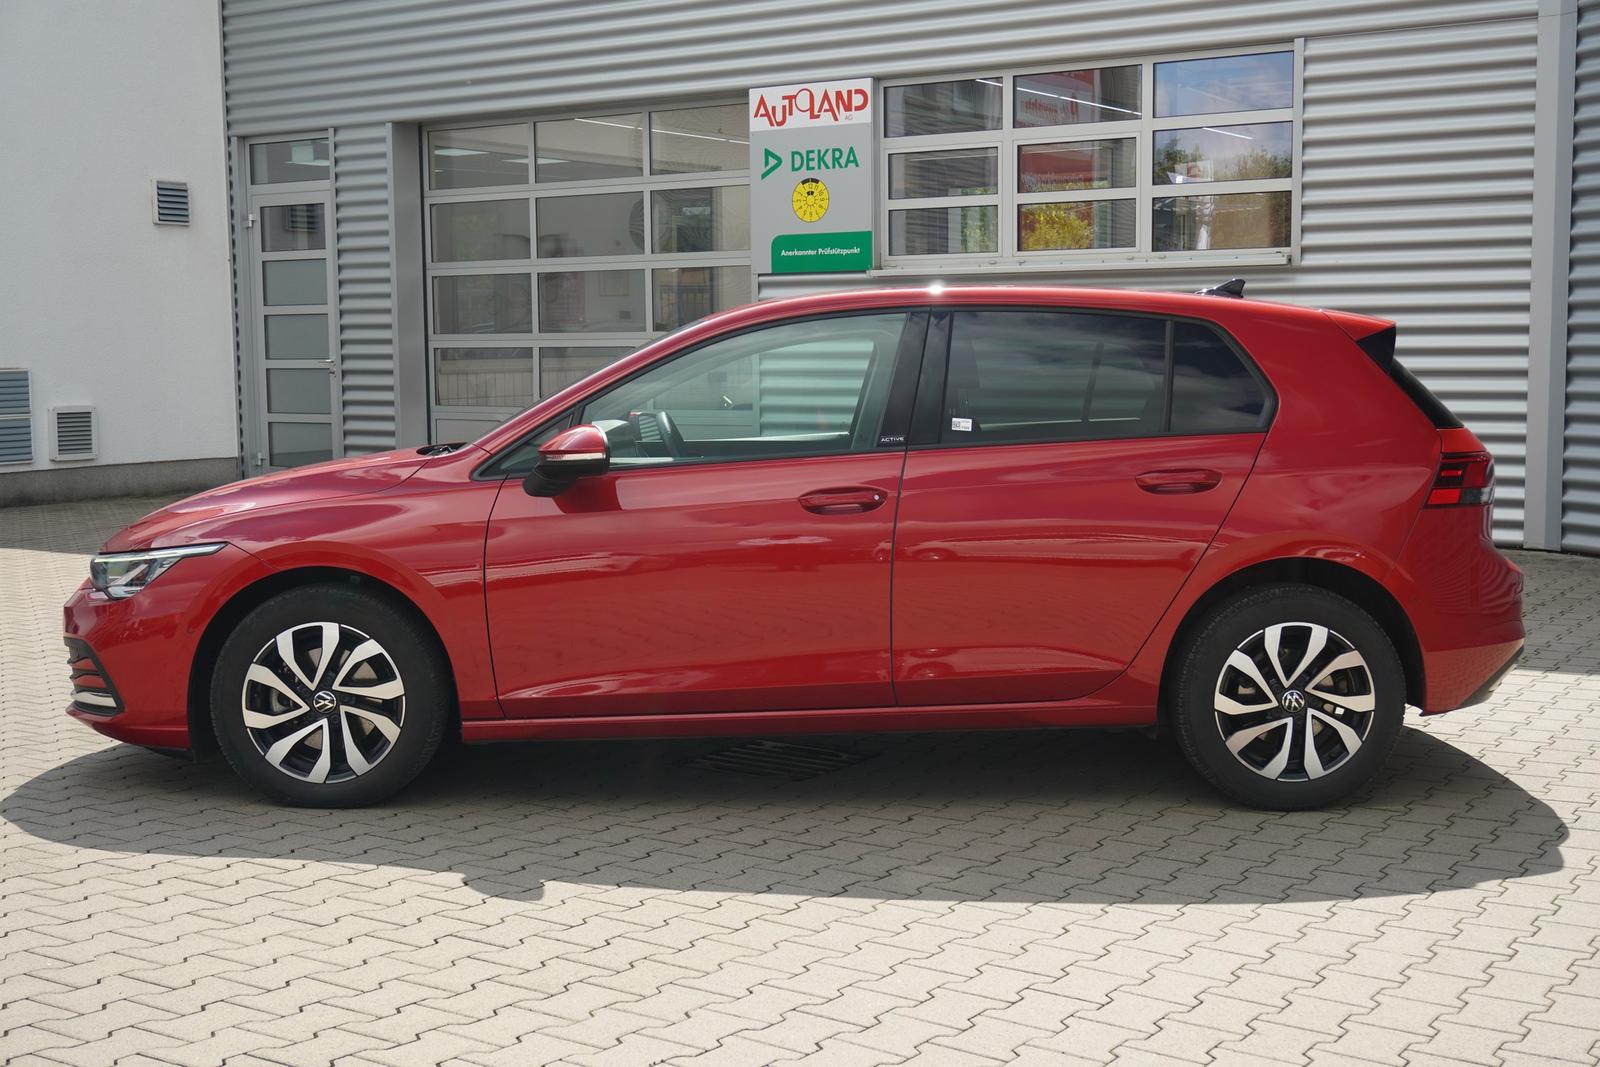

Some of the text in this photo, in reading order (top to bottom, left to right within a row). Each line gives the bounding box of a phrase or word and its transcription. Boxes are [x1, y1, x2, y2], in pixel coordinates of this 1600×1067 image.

[754, 88, 869, 127] AUTOLAND
[791, 145, 860, 172] DEKRA
[781, 246, 860, 257] Anerkannter Prüfstützpunkt
